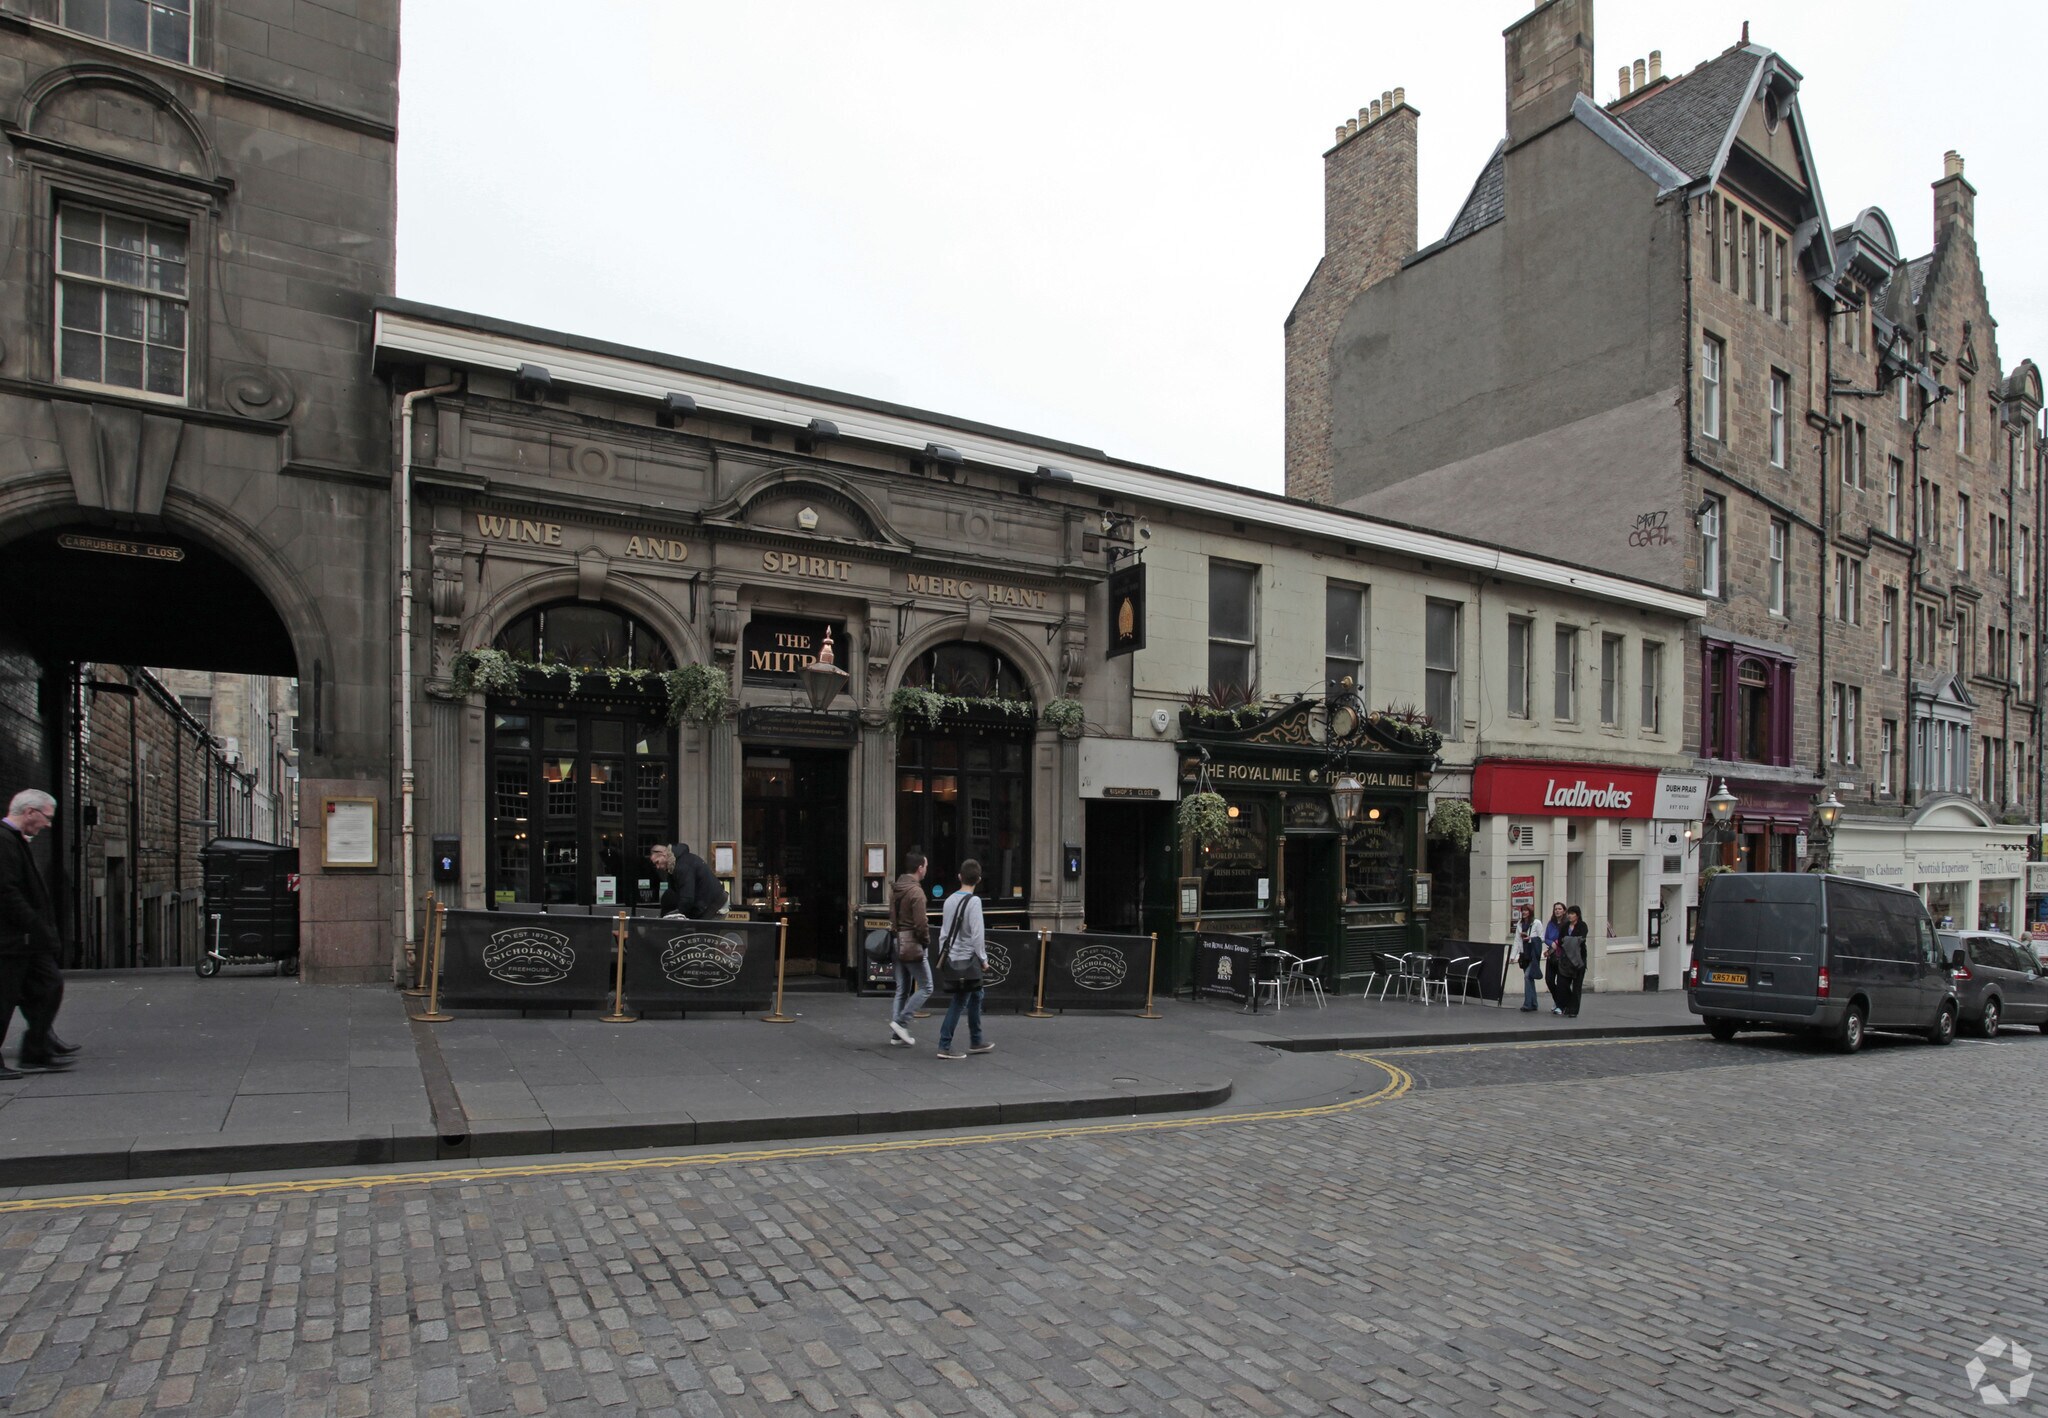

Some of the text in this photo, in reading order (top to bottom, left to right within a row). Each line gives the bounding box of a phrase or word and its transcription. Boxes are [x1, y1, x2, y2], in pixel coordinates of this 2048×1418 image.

[477, 514, 688, 562] WINE AND
[65, 537, 179, 558] CARRUBBERS CLOSE
[762, 551, 852, 581] SPIRIT
[775, 633, 811, 649] THE
[749, 650, 817, 673] MITR
[1228, 765, 1270, 780] ROYAL
[1271, 767, 1300, 782] MILE
[1388, 774, 1412, 787] MILE
[1138, 788, 1153, 796] CLOSE
[1543, 779, 1633, 809] Ladbrokes
[1665, 784, 1697, 794] DUBH PRAIS
[1876, 863, 1903, 876] Cashmere
[1918, 862, 1969, 877] Scottish Experience
[2033, 923, 2047, 932] EA
[532, 932, 549, 940] 1873
[492, 947, 567, 965] NICHOLSON'S
[669, 952, 734, 969] NICHOLSON'S
[1076, 960, 1121, 974] NICHOLSON'S
[1712, 973, 1745, 983] KR57 NTN
